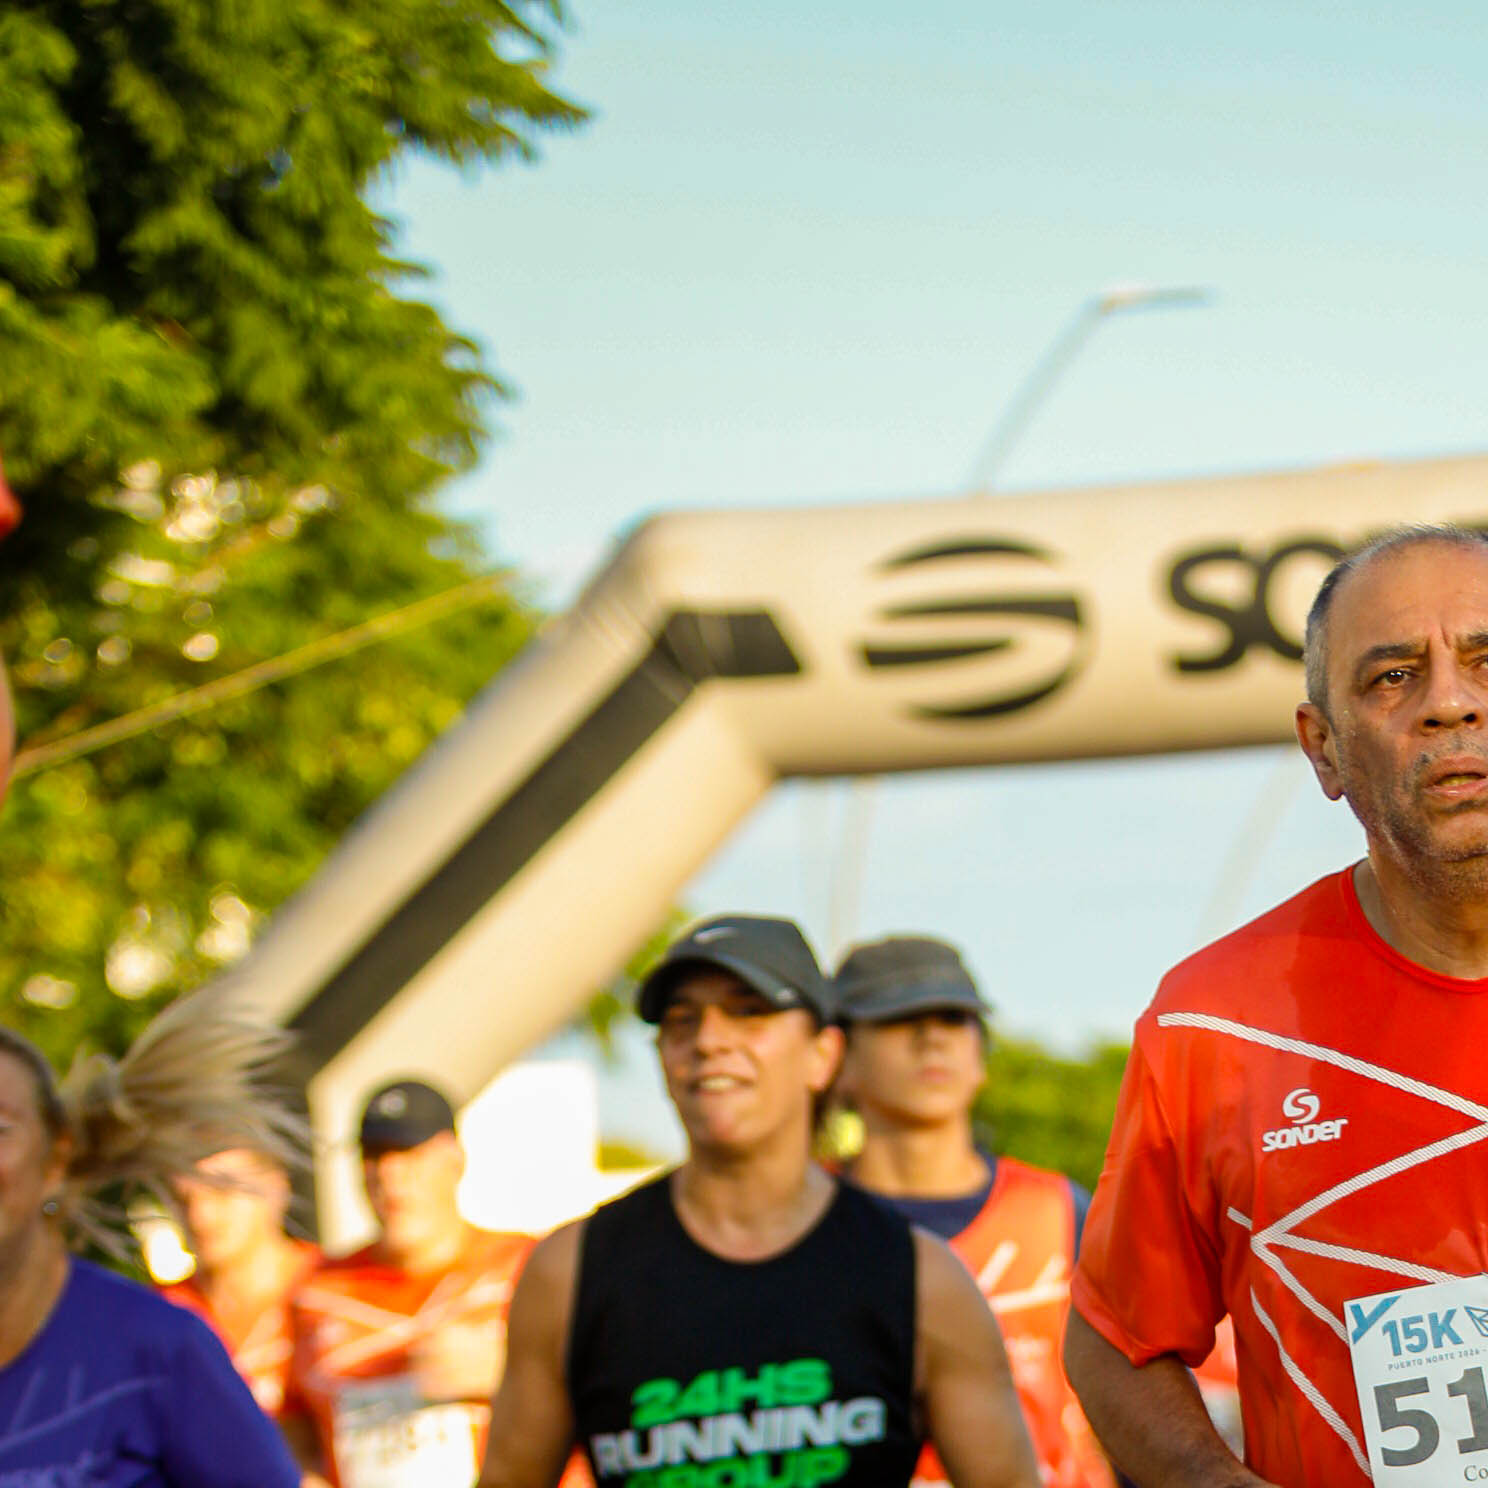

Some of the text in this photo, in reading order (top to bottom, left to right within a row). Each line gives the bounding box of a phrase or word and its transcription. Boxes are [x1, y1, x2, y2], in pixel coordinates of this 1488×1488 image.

[1382, 1308, 1464, 1357] 15K
[1388, 1358, 1423, 1371] PUERTO
[1426, 1351, 1455, 1364] NORTE
[630, 1357, 833, 1429] 24HS
[590, 1395, 887, 1479] RUNNING
